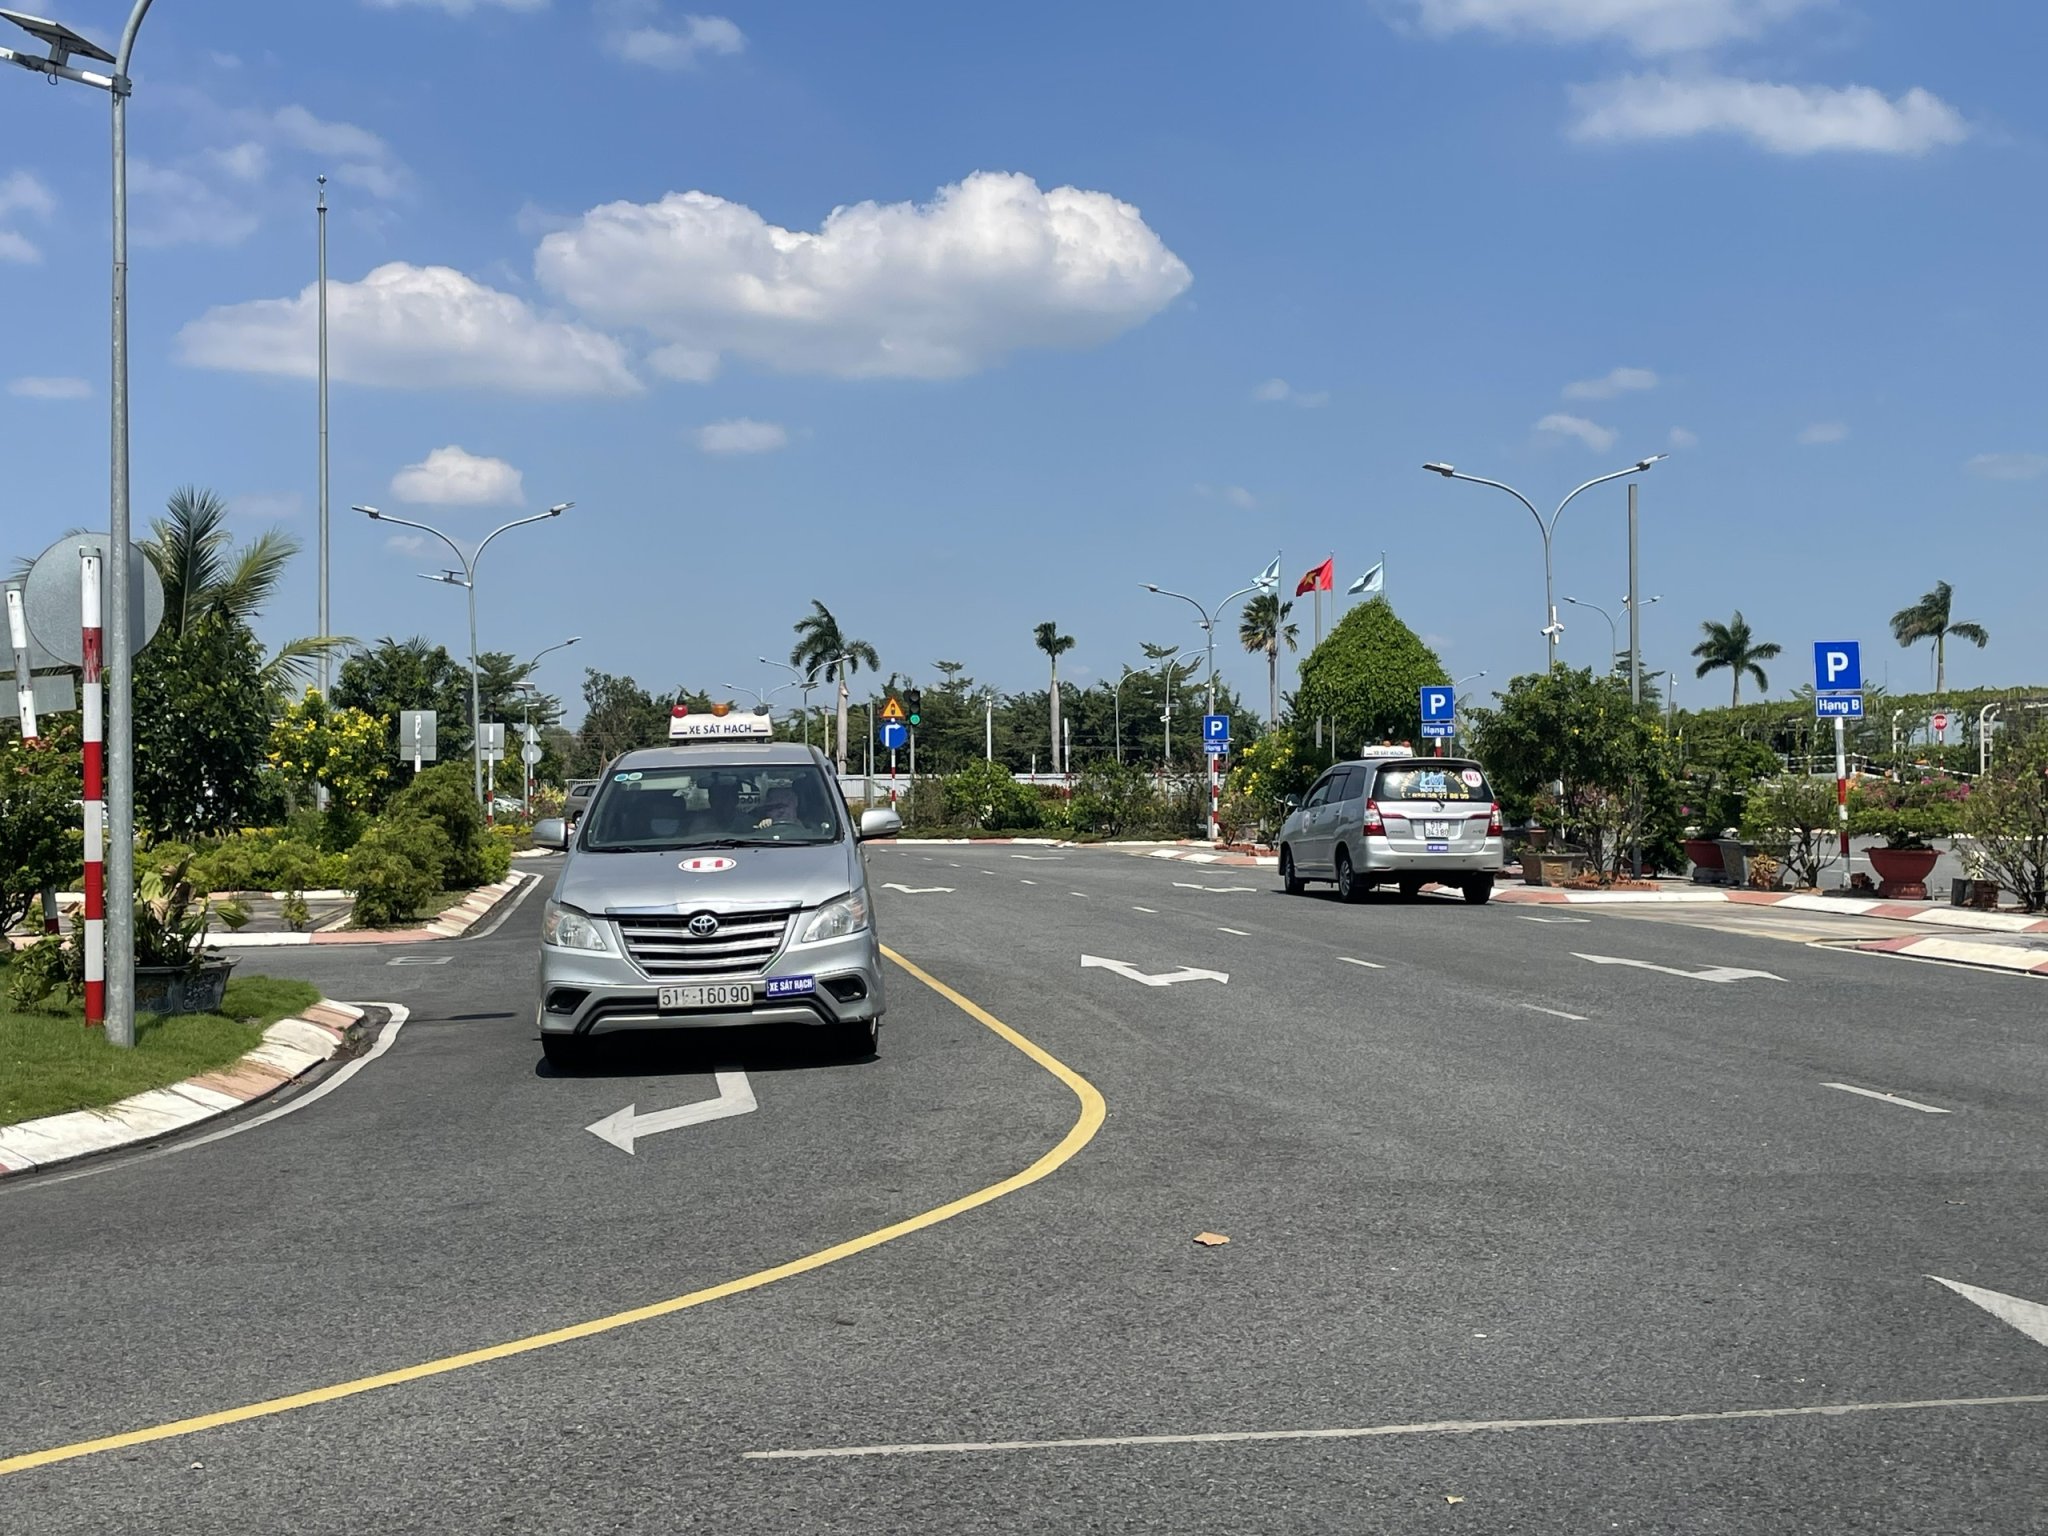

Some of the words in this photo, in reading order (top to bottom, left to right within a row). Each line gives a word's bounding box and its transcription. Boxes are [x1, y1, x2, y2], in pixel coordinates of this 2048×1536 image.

[1827, 652, 1848, 682] P
[1430, 694, 1446, 715] P
[1819, 699, 1849, 714] Hạng
[1851, 699, 1860, 711] B
[689, 725, 701, 735] XE
[703, 723, 721, 735] SÁT
[1211, 721, 1223, 736] P
[769, 982, 779, 992] XE
[780, 979, 793, 991] SÁT
[794, 979, 813, 991] HẠCH
